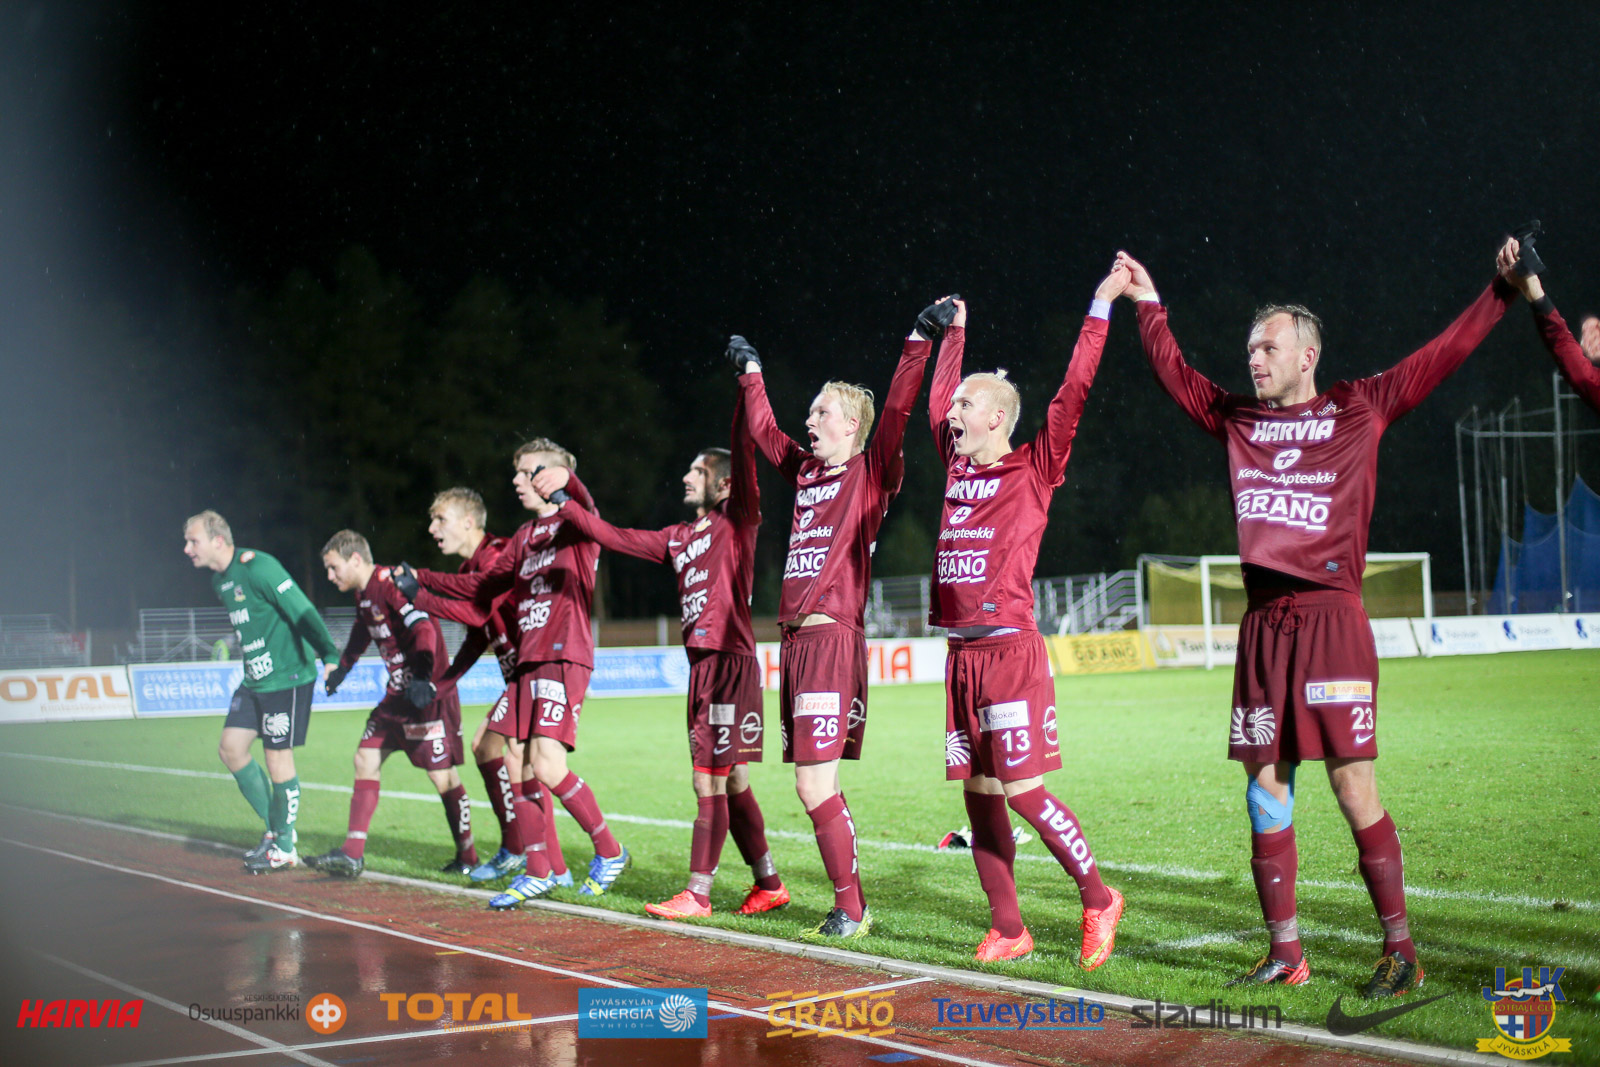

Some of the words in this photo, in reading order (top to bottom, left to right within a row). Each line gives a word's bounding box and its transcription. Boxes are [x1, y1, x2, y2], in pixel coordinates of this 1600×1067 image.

[1250, 419, 1336, 442] HARVIA
[945, 478, 1001, 500] ARVIA
[1237, 495, 1329, 523] GRANO
[0, 674, 129, 703] OTAL
[142, 682, 226, 700] ENERGIA
[542, 701, 565, 722] 16
[1351, 706, 1374, 730] 23
[717, 726, 730, 745] 2
[812, 716, 839, 737] 26
[432, 738, 445, 755] 5
[1001, 729, 1030, 752] 13
[1040, 798, 1094, 875] TOTAL
